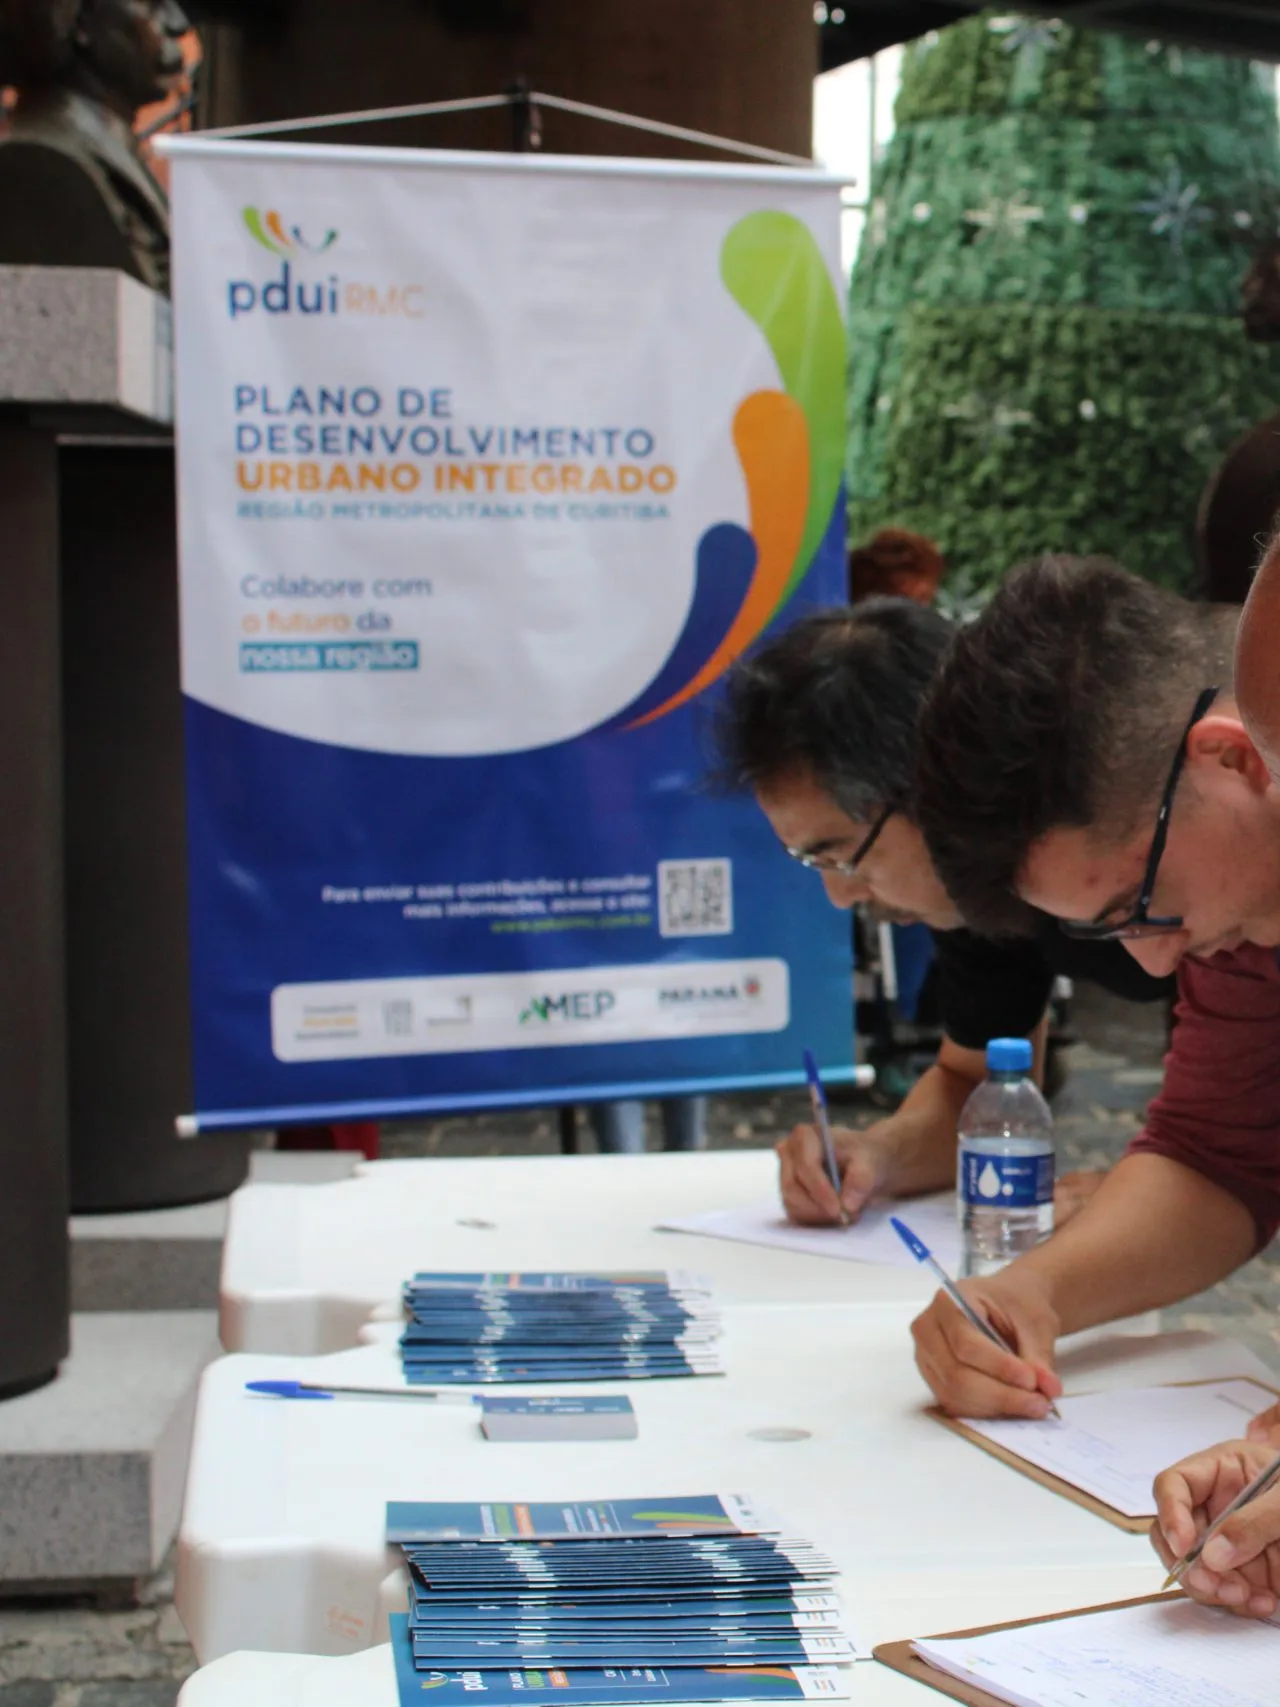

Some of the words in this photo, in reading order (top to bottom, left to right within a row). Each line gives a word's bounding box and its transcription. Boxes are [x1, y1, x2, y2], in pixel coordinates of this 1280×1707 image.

[235, 384, 382, 417] PLANO
[397, 387, 452, 418] DE
[236, 422, 655, 457] DESENVOLVIMENTO
[236, 458, 421, 493] URBANO
[434, 461, 677, 495] INTEGRADO
[236, 498, 324, 520] REGIÃO
[330, 501, 526, 520] METROPOLITANA
[532, 503, 559, 519] DE
[566, 502, 670, 520] CURITIBA
[240, 573, 365, 598] Colabore
[371, 578, 433, 598] com
[240, 613, 262, 634] o
[266, 608, 352, 634] futuro
[355, 607, 393, 633] da
[241, 645, 320, 670] nossa
[325, 641, 415, 672] região
